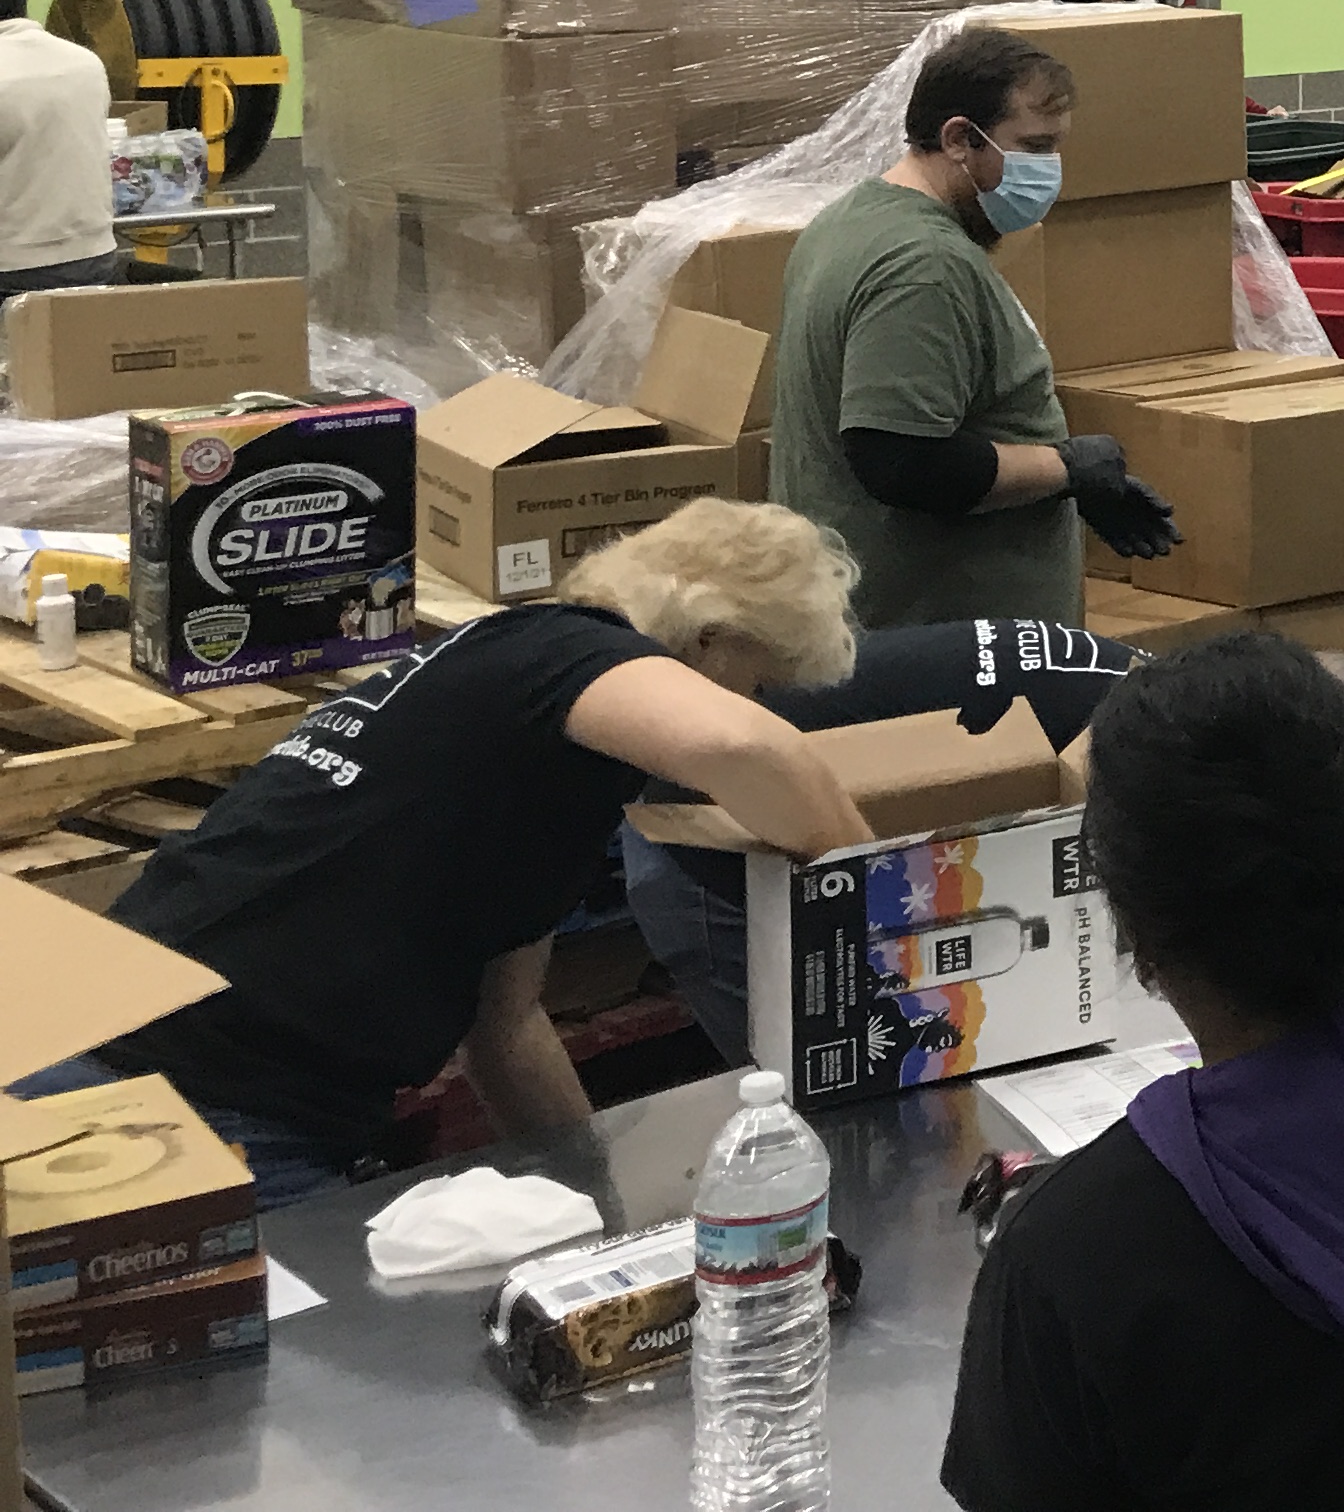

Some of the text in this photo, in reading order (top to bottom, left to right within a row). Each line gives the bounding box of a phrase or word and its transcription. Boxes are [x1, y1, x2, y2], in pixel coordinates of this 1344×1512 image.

[345, 416, 375, 429] DUST
[249, 494, 341, 518] PLATINUM
[517, 482, 716, 513] Ferrero 4 Tier Bin Program
[216, 516, 371, 567] SLIDE
[512, 551, 539, 567] FL
[1017, 629, 1042, 672] CLUB
[182, 659, 280, 687] MULTI-CAT
[1061, 840, 1081, 891] WTR
[820, 870, 855, 899] 6
[941, 942, 954, 973] WTR
[954, 939, 967, 971] LIFE
[1074, 906, 1092, 1025] pH BALANCED
[88, 1241, 190, 1284] Cheerios
[627, 1319, 692, 1353] UNKY
